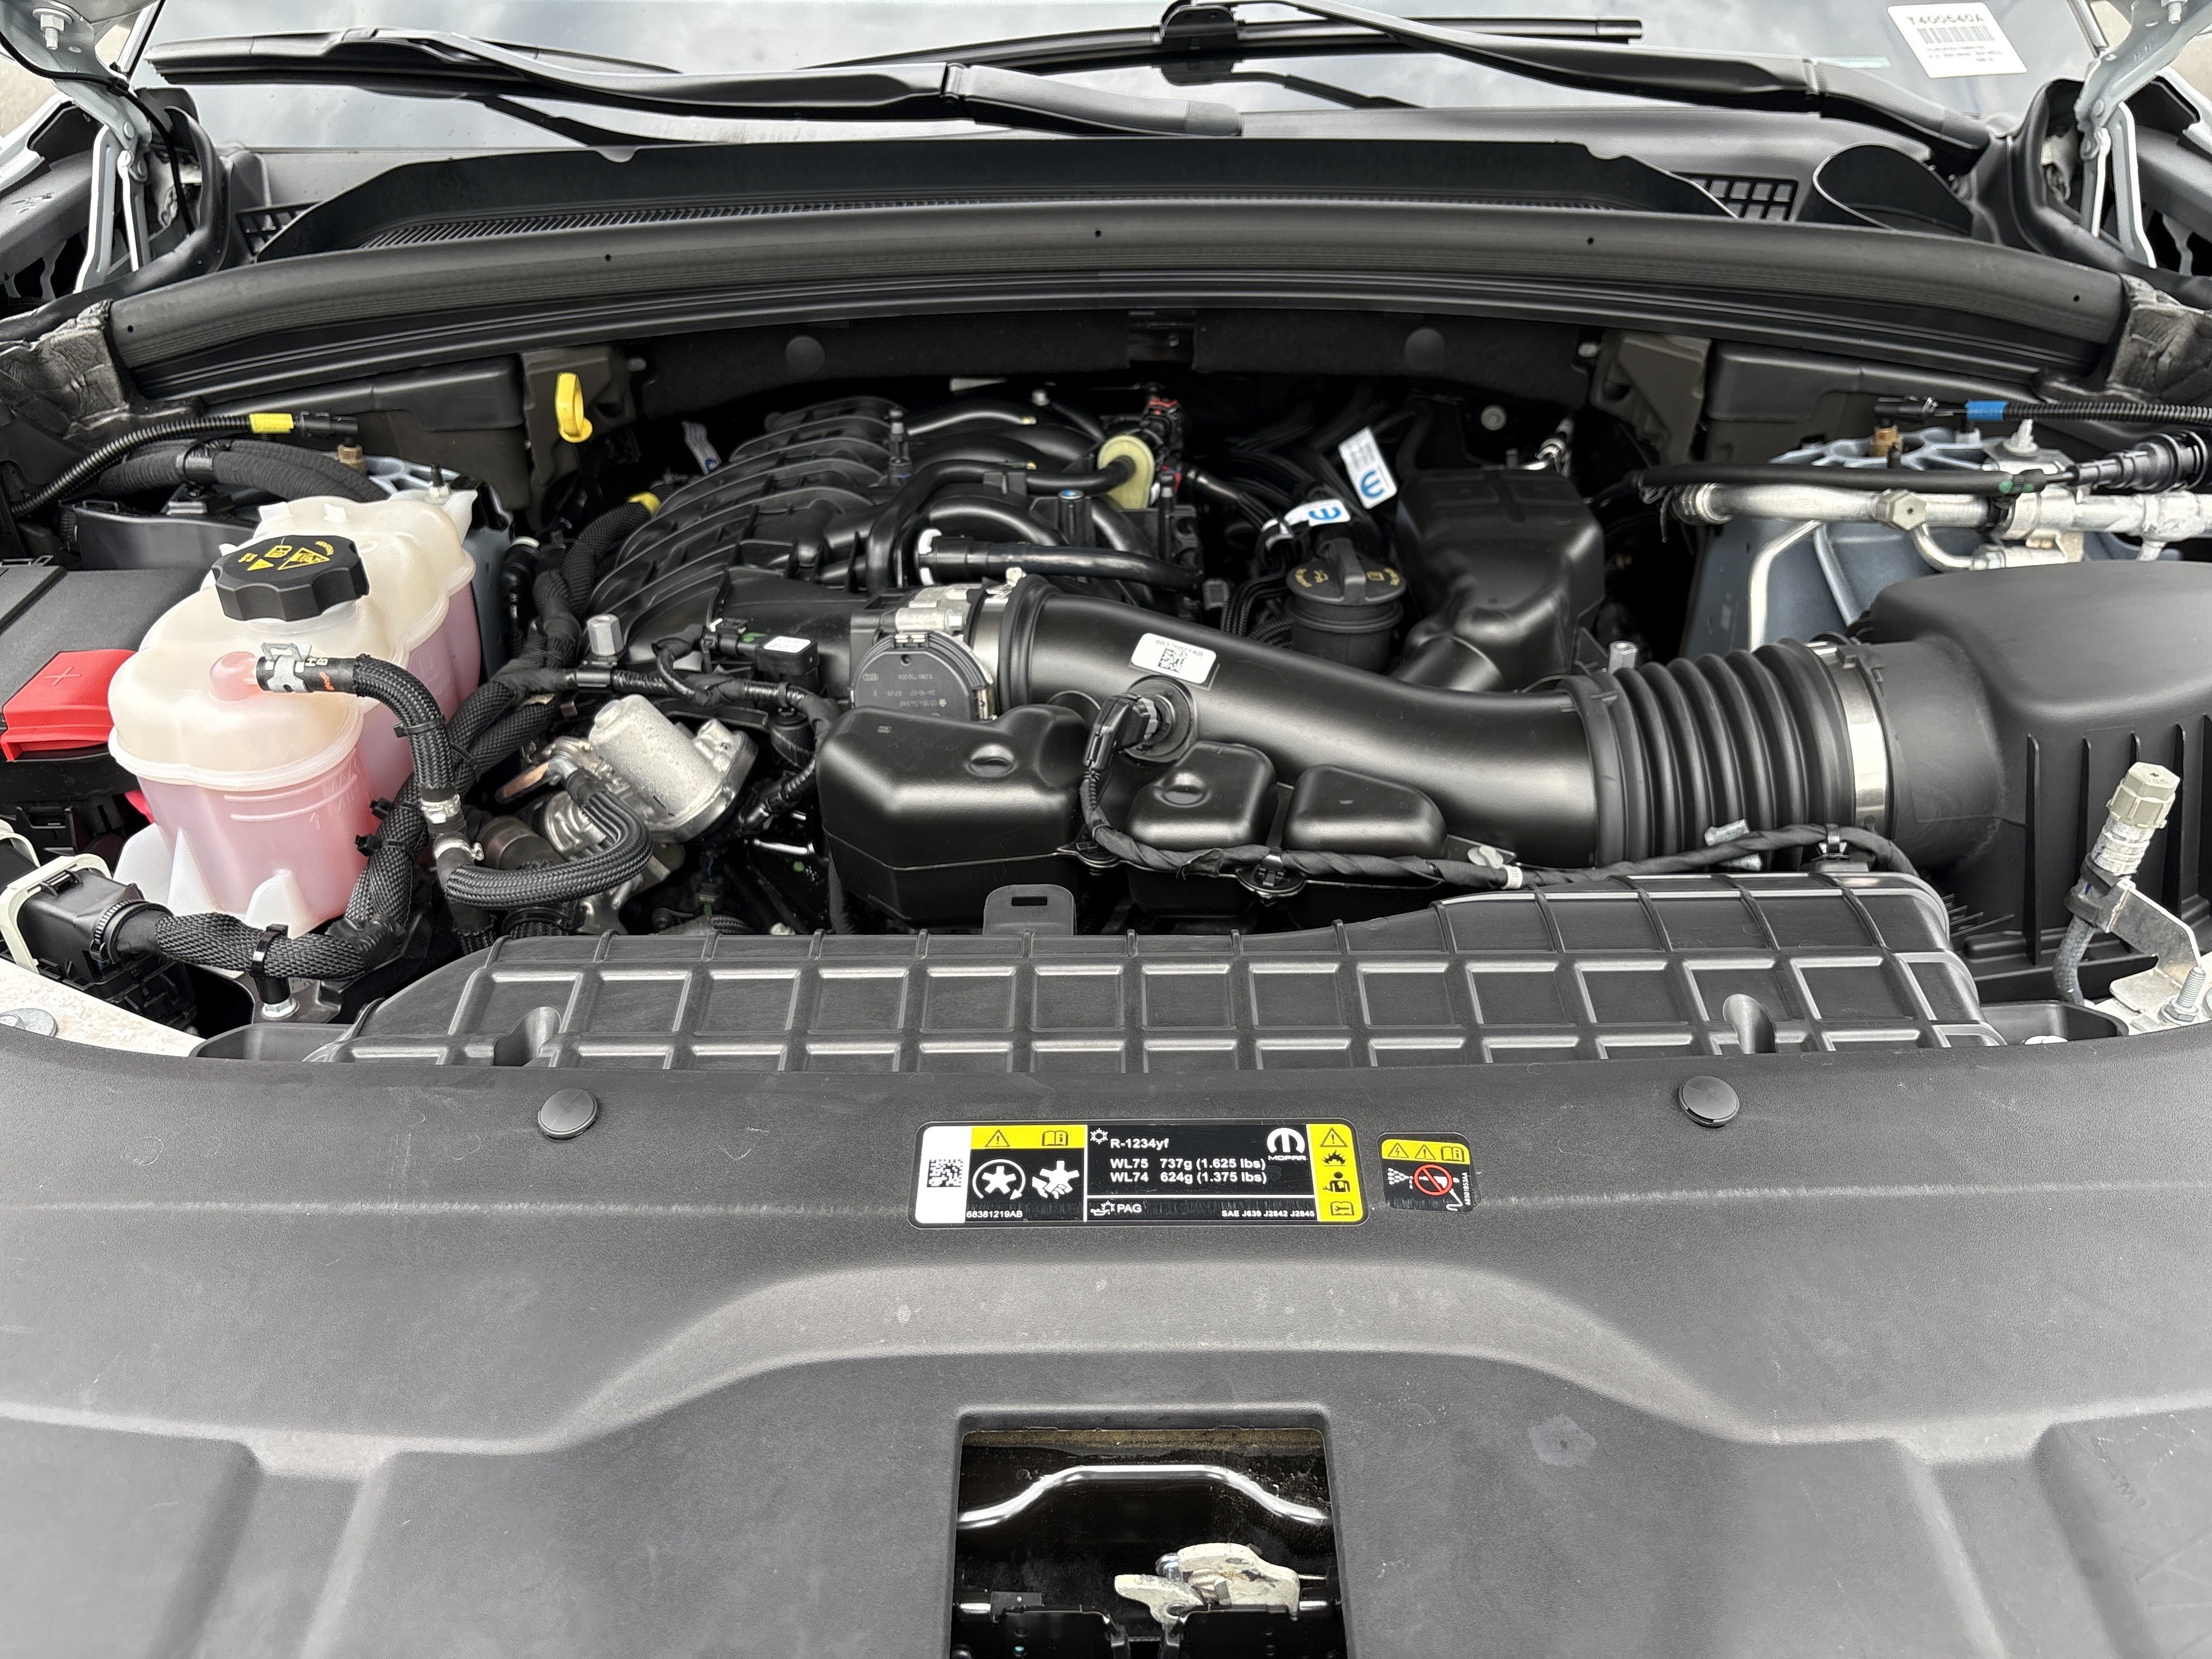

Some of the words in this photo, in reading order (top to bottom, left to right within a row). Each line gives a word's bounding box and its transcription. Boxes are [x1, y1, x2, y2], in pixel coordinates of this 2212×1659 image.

[1110, 1138, 1169, 1150] R-1234yf
[1110, 1158, 1148, 1169] WL75
[1160, 1158, 1192, 1171] 737g
[1197, 1158, 1237, 1171] (1.625
[1240, 1158, 1266, 1171] lbs)
[1110, 1171, 1149, 1182] WL74
[1160, 1171, 1193, 1184] 624g
[1197, 1171, 1238, 1184] (1.375
[1241, 1171, 1267, 1184] lbs)
[1117, 1204, 1142, 1213] PAG
